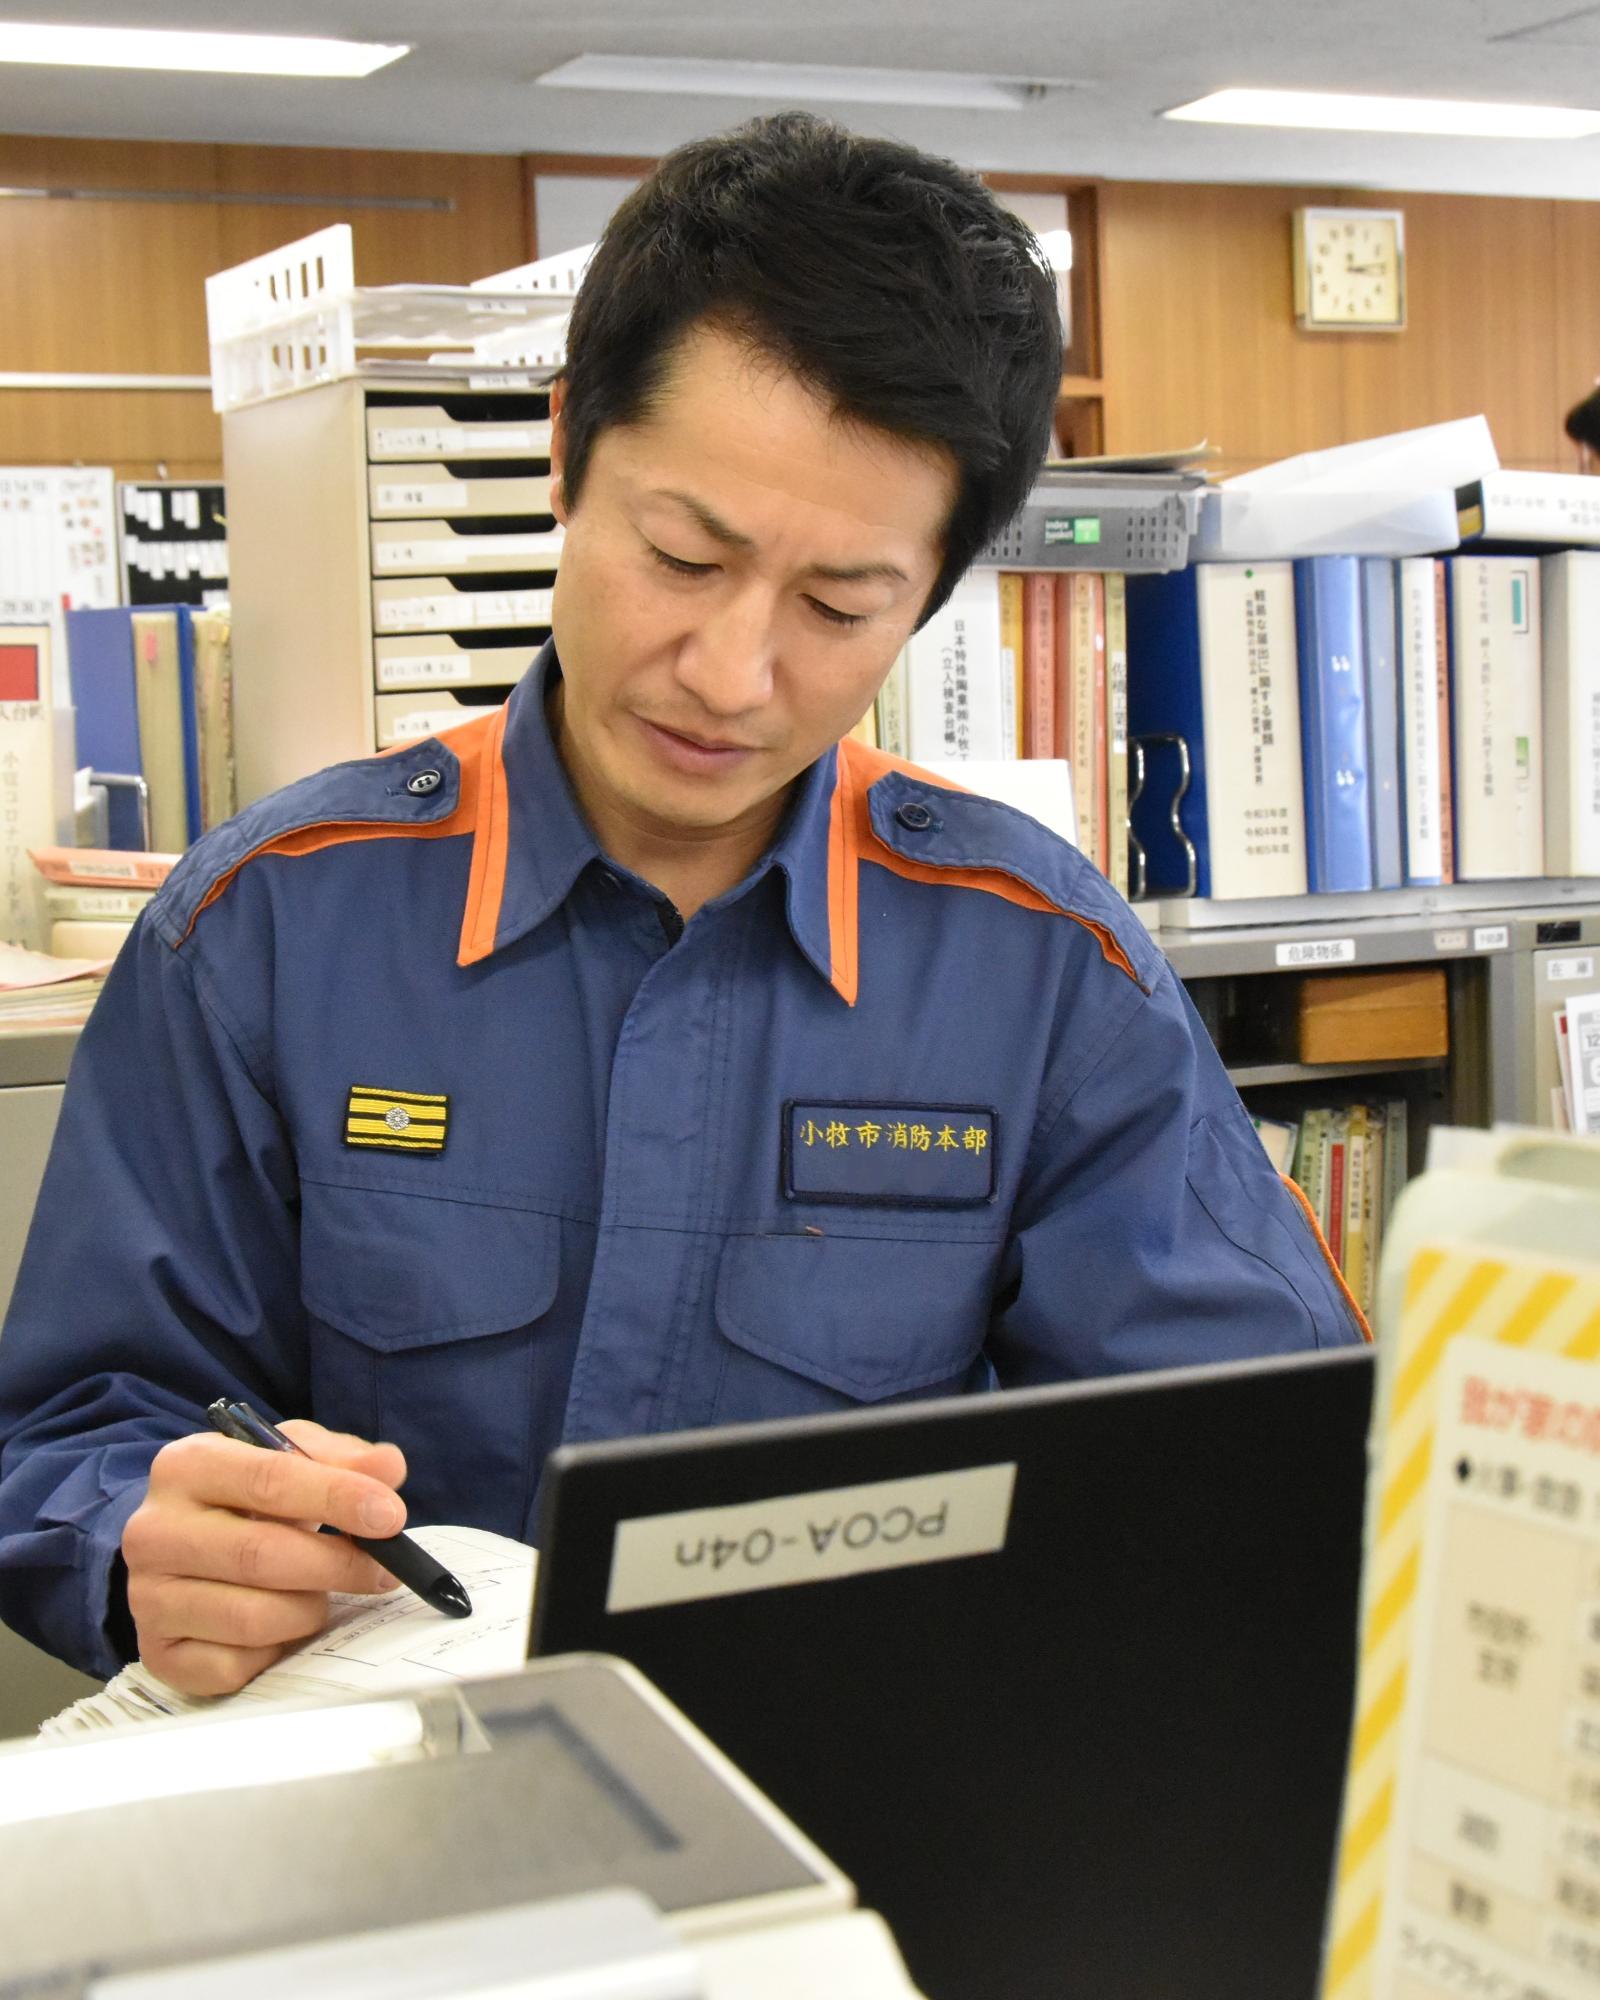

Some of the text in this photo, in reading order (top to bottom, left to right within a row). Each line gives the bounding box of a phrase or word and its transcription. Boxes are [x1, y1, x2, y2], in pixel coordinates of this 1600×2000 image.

[1287, 944, 1345, 964] 危険物係
[800, 1119, 989, 1155] 小牧市消防本部
